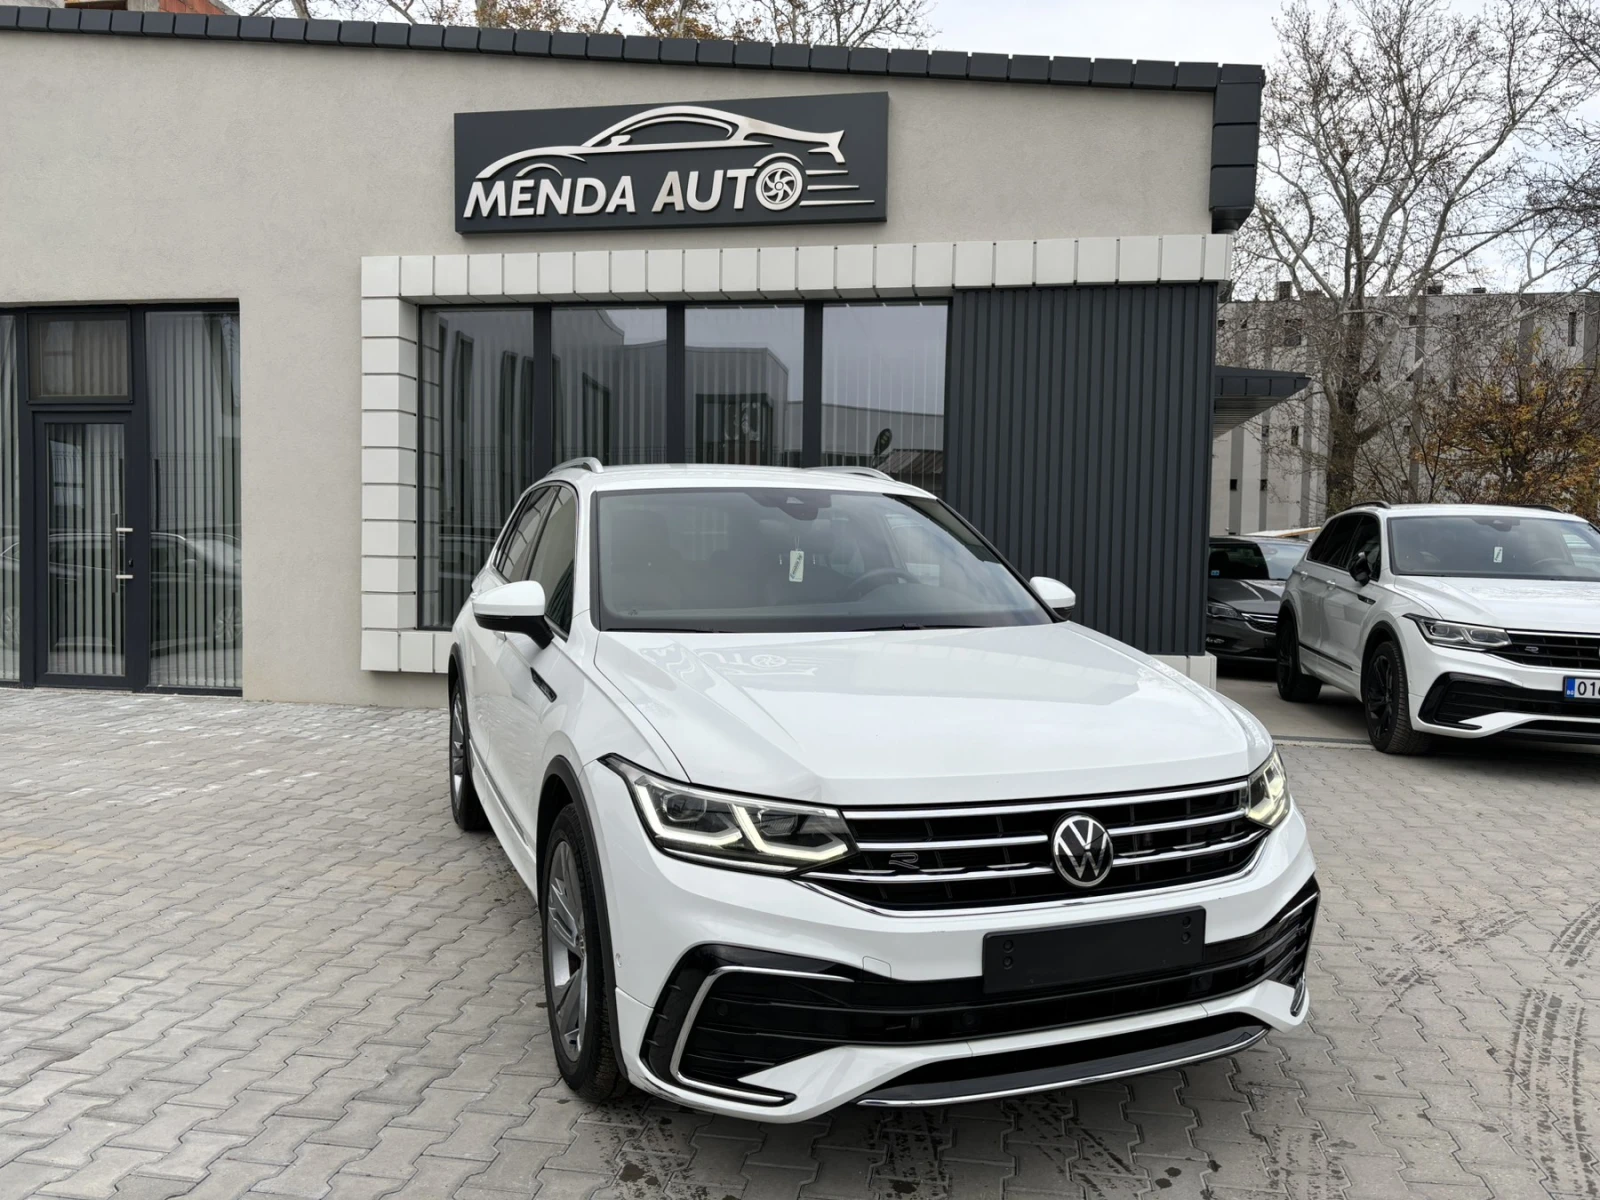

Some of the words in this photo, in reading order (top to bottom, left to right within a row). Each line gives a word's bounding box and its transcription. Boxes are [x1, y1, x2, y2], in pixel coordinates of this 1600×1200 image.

[463, 175, 636, 218] MENDA
[651, 162, 803, 212] AUTO
[1577, 681, 1600, 696] 01
